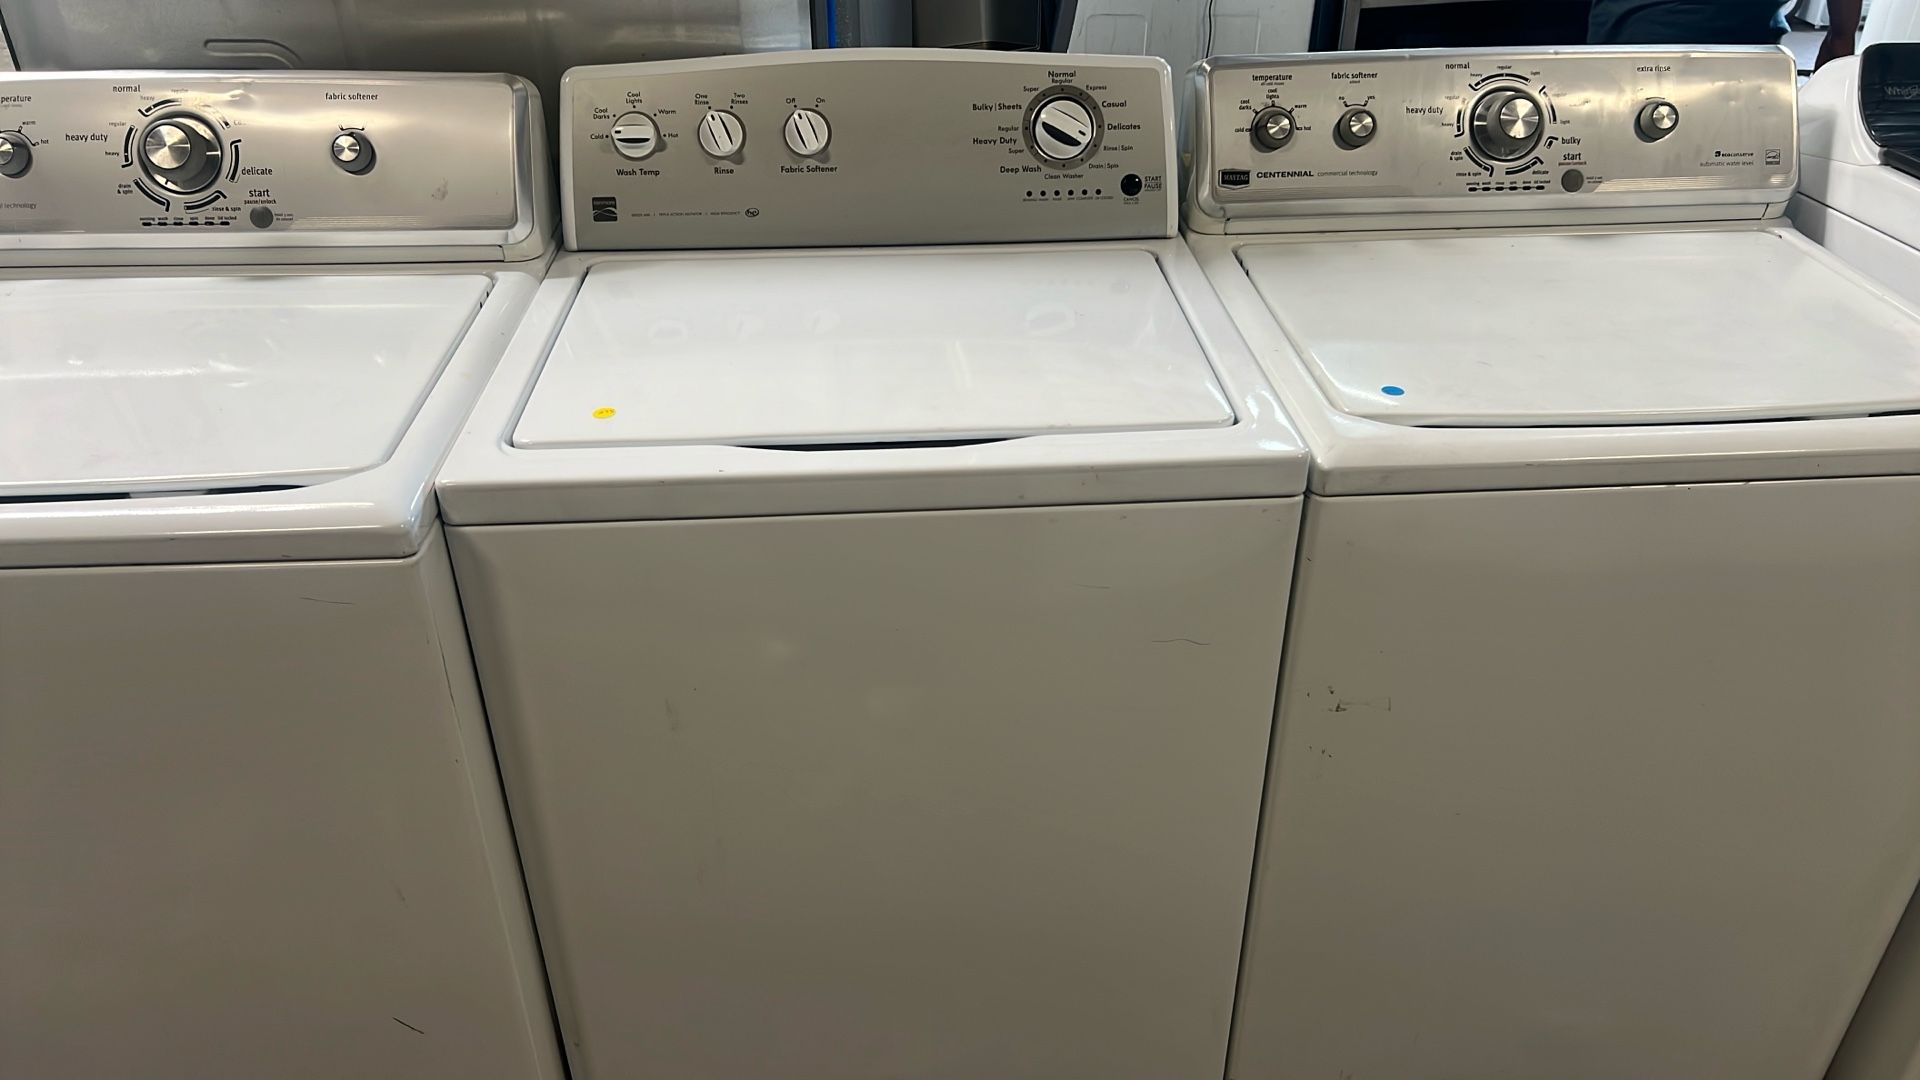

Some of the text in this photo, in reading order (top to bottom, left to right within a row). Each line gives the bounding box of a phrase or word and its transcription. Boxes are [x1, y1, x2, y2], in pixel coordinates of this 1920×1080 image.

[1654, 64, 1671, 72] rinse
[1048, 70, 1076, 78] Normal
[1252, 74, 1293, 82] temperature
[1351, 71, 1378, 79] softener
[112, 84, 141, 93] normal
[325, 92, 379, 100] fabric softener
[1405, 106, 1444, 114] heavy duty
[1107, 123, 1141, 131] Delicates
[65, 132, 109, 143] heavy duty
[972, 137, 1018, 146] Heavy Duty
[1561, 136, 1581, 145] bulky
[1562, 152, 1582, 161] start
[241, 166, 273, 176] delicate
[616, 168, 660, 177] Wash Temp
[714, 166, 735, 175] Rinse
[781, 165, 838, 174] Fabric Softener
[1000, 165, 1042, 174] Deep Wash
[1256, 170, 1314, 178] CENTENNIAL
[249, 188, 270, 198] start
[4, 202, 37, 210] technology
